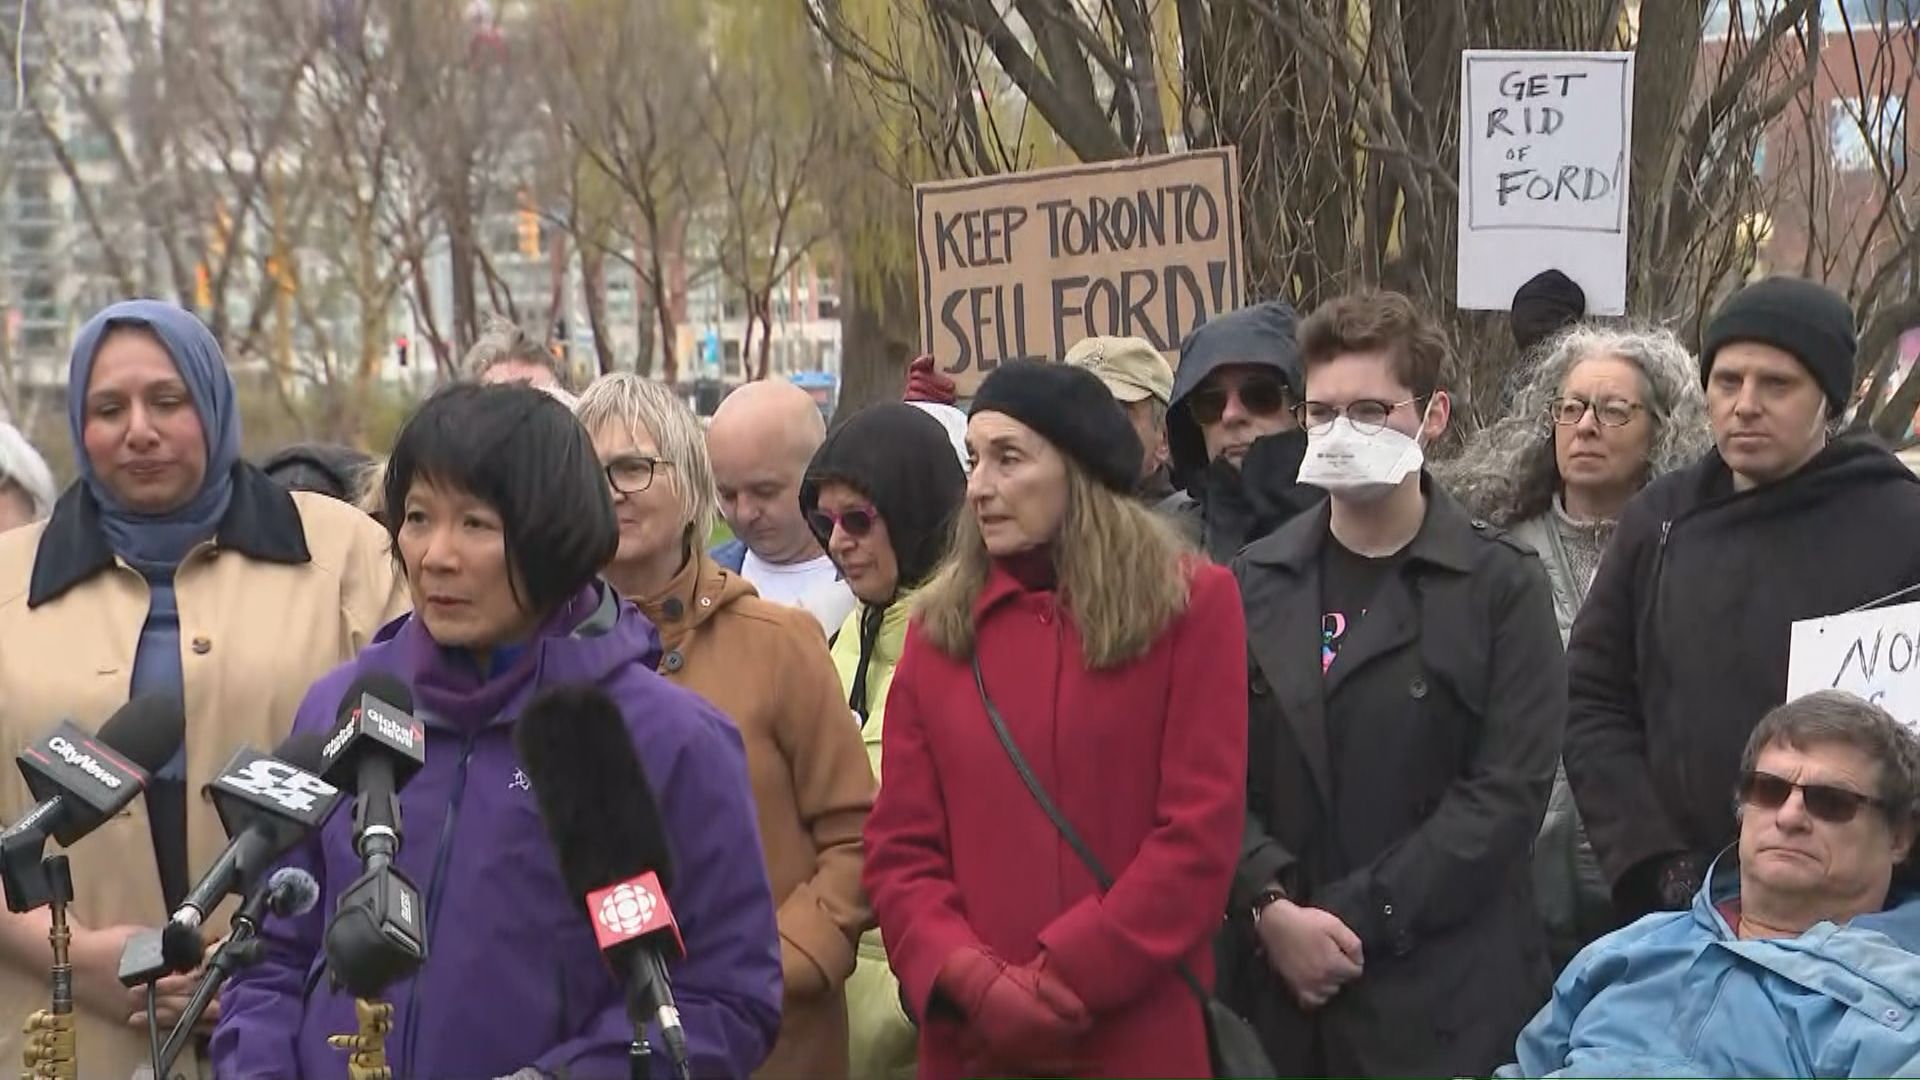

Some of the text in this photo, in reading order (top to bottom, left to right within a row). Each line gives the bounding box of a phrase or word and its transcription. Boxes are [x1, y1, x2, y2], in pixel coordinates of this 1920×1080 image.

[1500, 70, 1587, 101] GET
[1486, 107, 1564, 138] RID
[1506, 145, 1532, 161] OF
[1496, 150, 1624, 206] FORD!
[934, 184, 1219, 271] KEEP TORONTO
[1051, 261, 1227, 361] FORD!
[367, 709, 413, 741] Global
